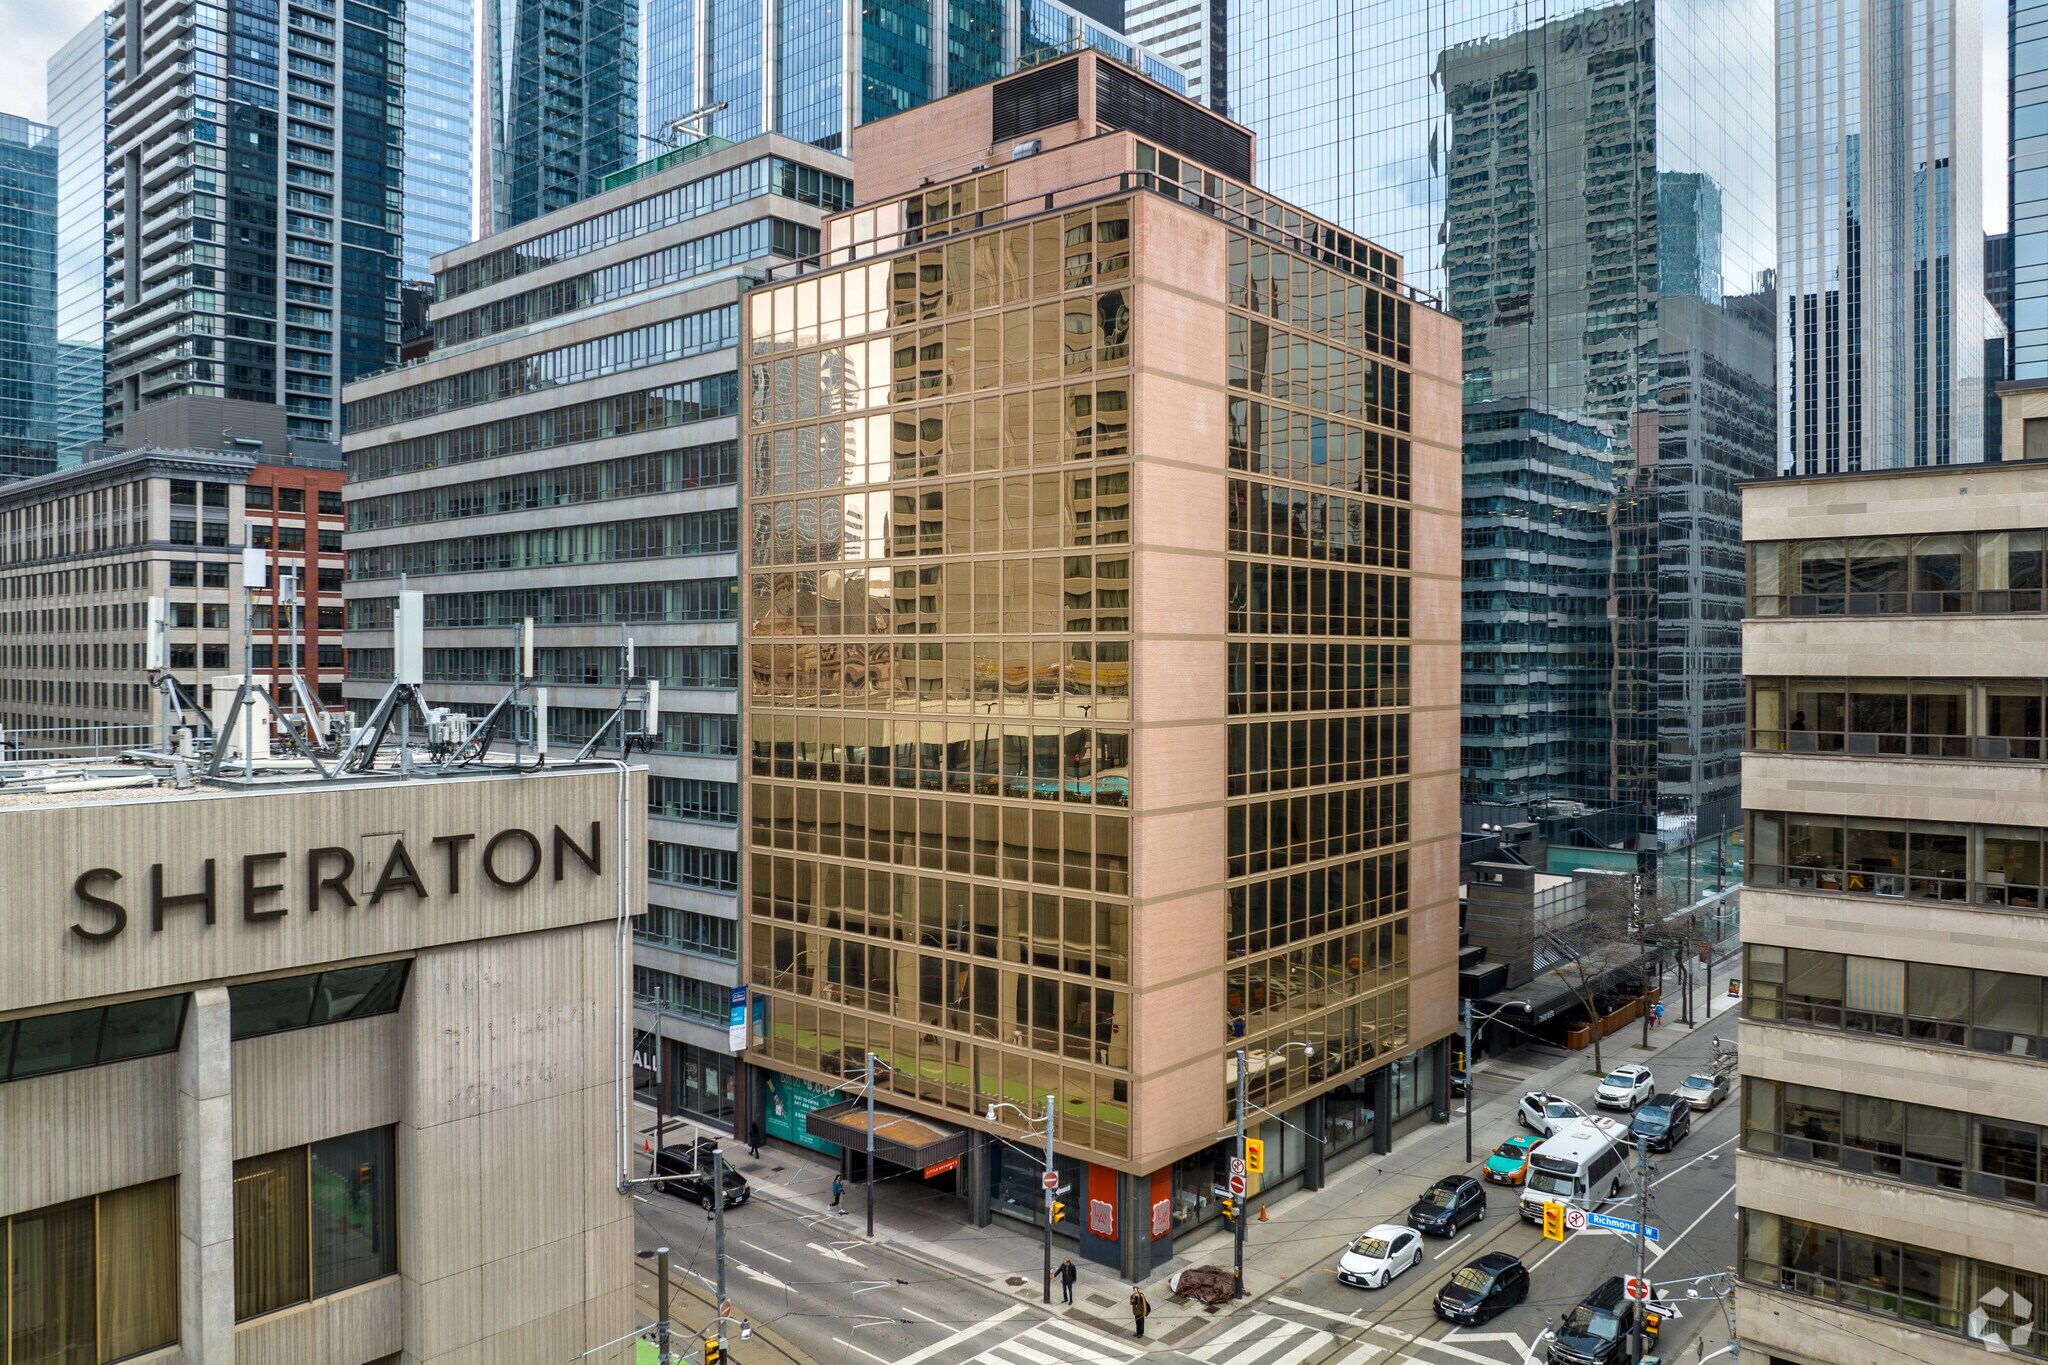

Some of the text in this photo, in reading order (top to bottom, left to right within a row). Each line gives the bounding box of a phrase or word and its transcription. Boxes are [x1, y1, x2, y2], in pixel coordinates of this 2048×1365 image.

[70, 821, 601, 941] SHERATON
[1593, 1214, 1653, 1236] Richmond W
